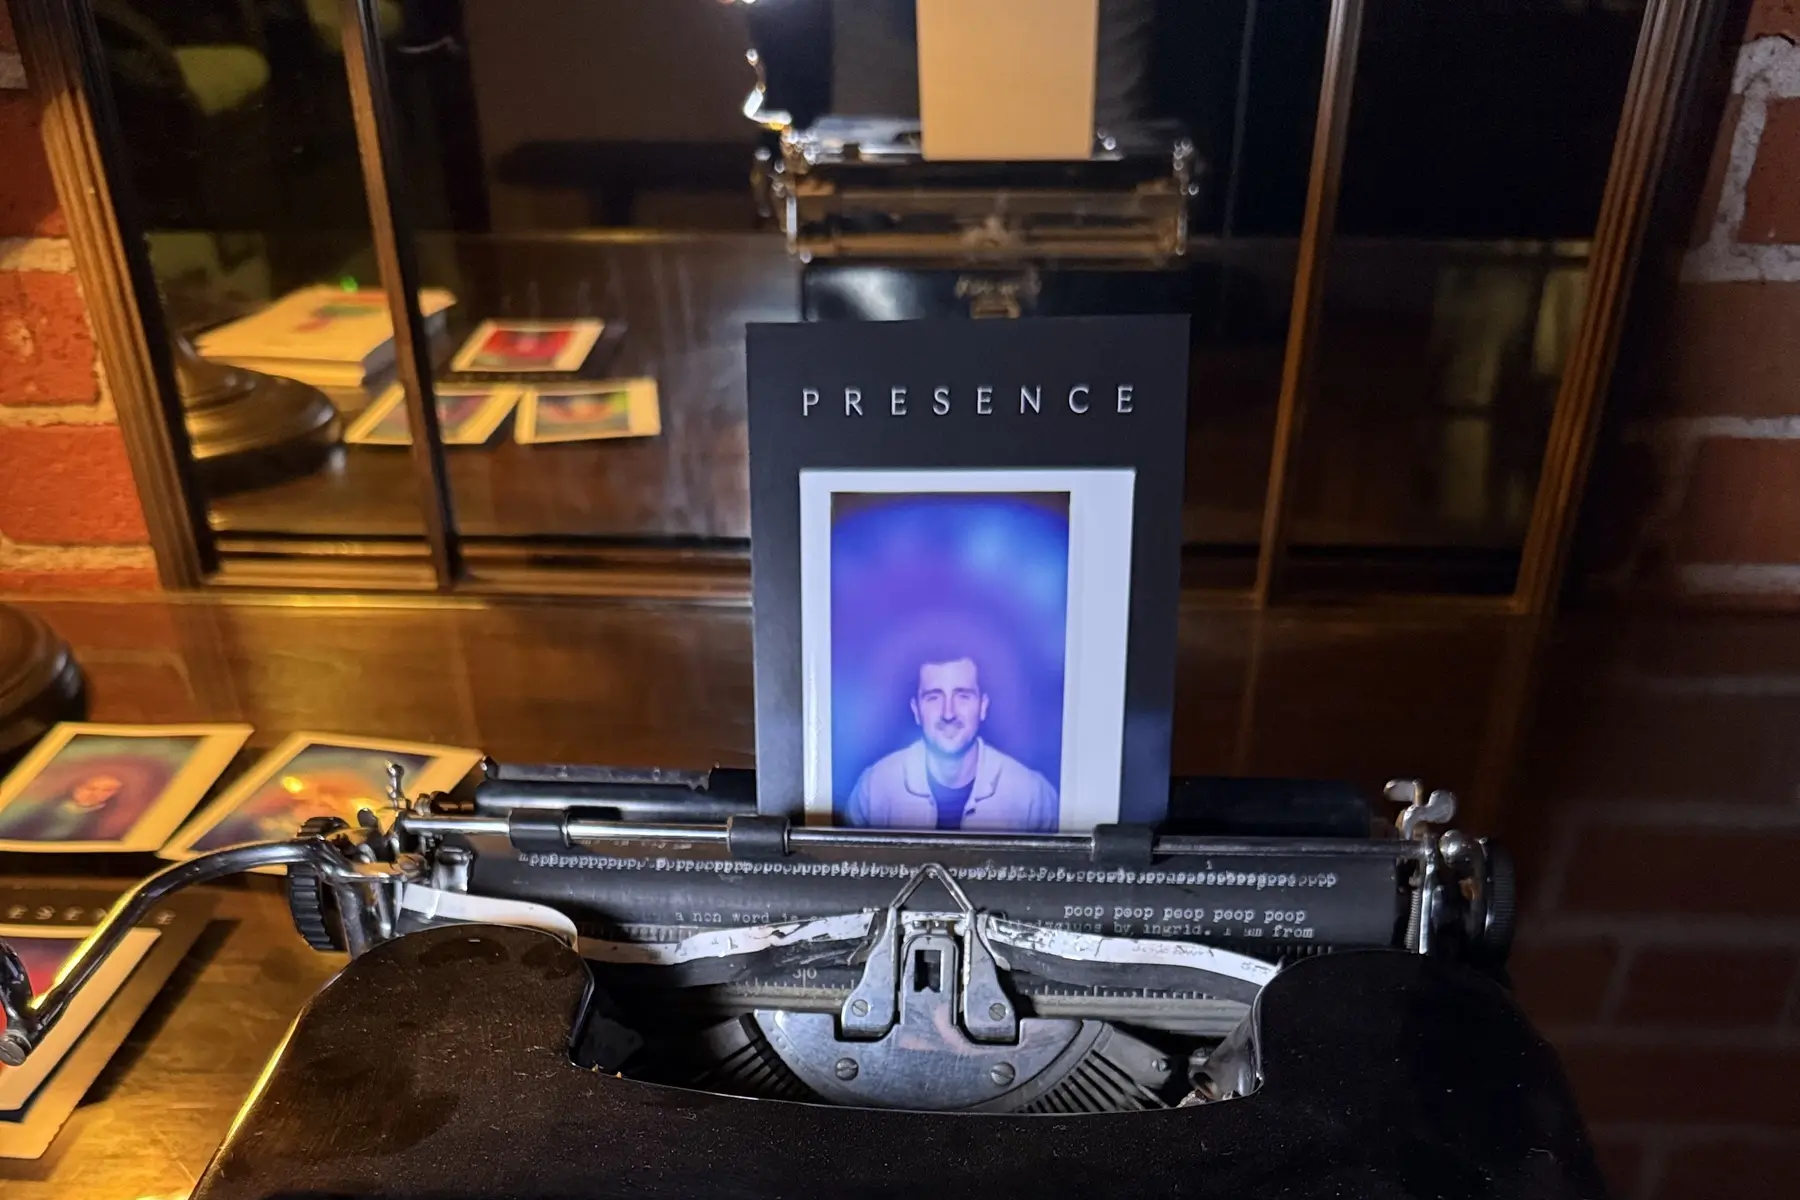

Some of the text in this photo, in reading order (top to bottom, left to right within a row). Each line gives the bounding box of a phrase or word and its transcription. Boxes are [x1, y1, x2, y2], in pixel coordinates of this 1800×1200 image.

[802, 385, 1134, 417] PRESENCE
[732, 912, 770, 924] word
[1064, 905, 1306, 924] poop poop poop poop poop
[1272, 924, 1315, 938] from
